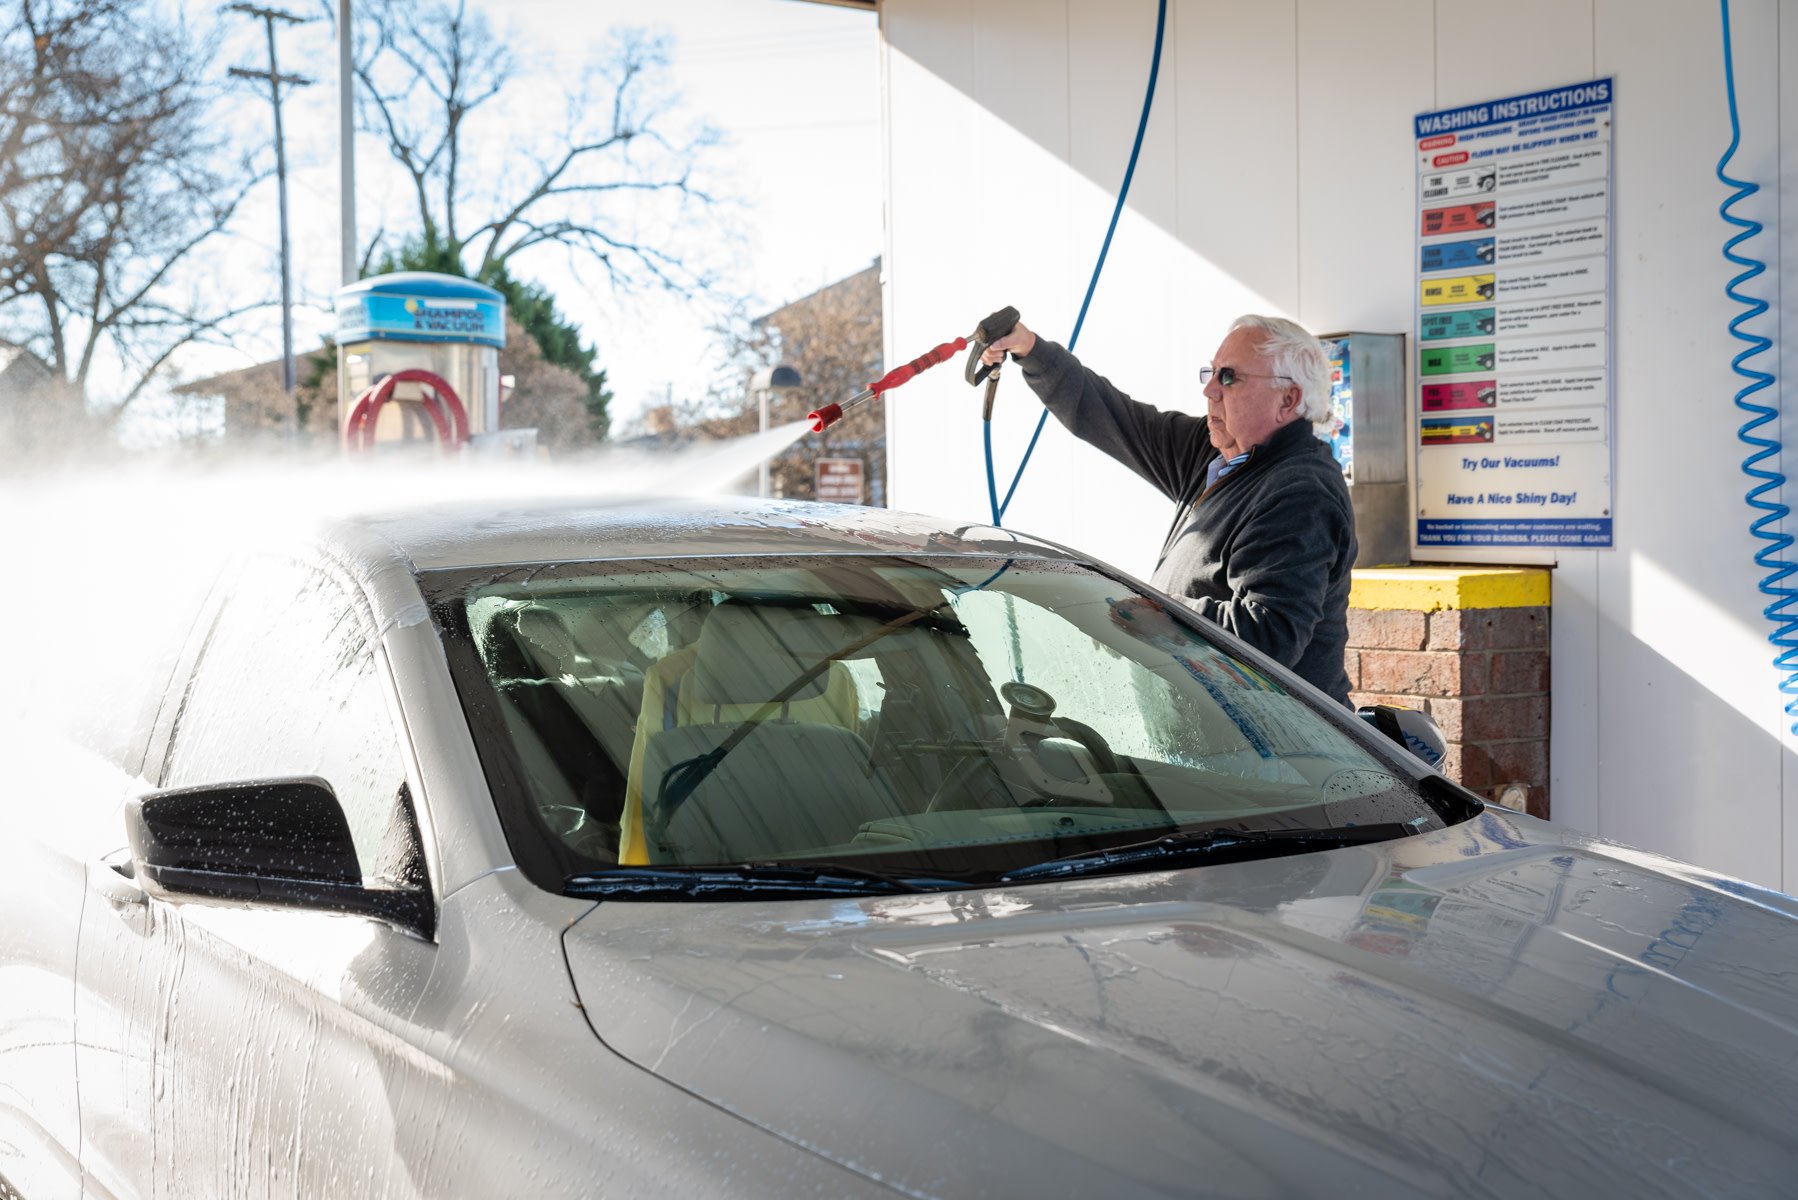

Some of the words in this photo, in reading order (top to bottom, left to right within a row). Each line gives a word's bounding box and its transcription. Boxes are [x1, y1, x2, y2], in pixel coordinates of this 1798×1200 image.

[1418, 107, 1489, 134] WASHING
[1493, 84, 1609, 120] INSTRUCTIONS
[1475, 126, 1513, 139] PRESSURE
[1435, 154, 1467, 166] CAUTION
[1471, 149, 1494, 160] FLOOR
[1496, 145, 1510, 155] MAY
[1511, 144, 1521, 152] BE
[1522, 138, 1557, 151] SLIPPERY
[1558, 134, 1581, 144] WHEN
[1582, 130, 1599, 140] WET
[1462, 458, 1478, 471] Try
[1481, 457, 1501, 469] Our
[1504, 456, 1560, 468] Vacuums!
[1447, 494, 1474, 505] Have
[1477, 494, 1485, 504] A
[1487, 493, 1513, 504] Nice
[1516, 492, 1547, 506] Shiny
[1550, 492, 1577, 506] Day!
[1420, 534, 1442, 542] THANK
[1443, 534, 1457, 542] YOU
[1457, 534, 1471, 542] FOR
[1473, 534, 1492, 542] YOUR
[1531, 533, 1559, 542] PLEASE
[1560, 533, 1582, 542] COME
